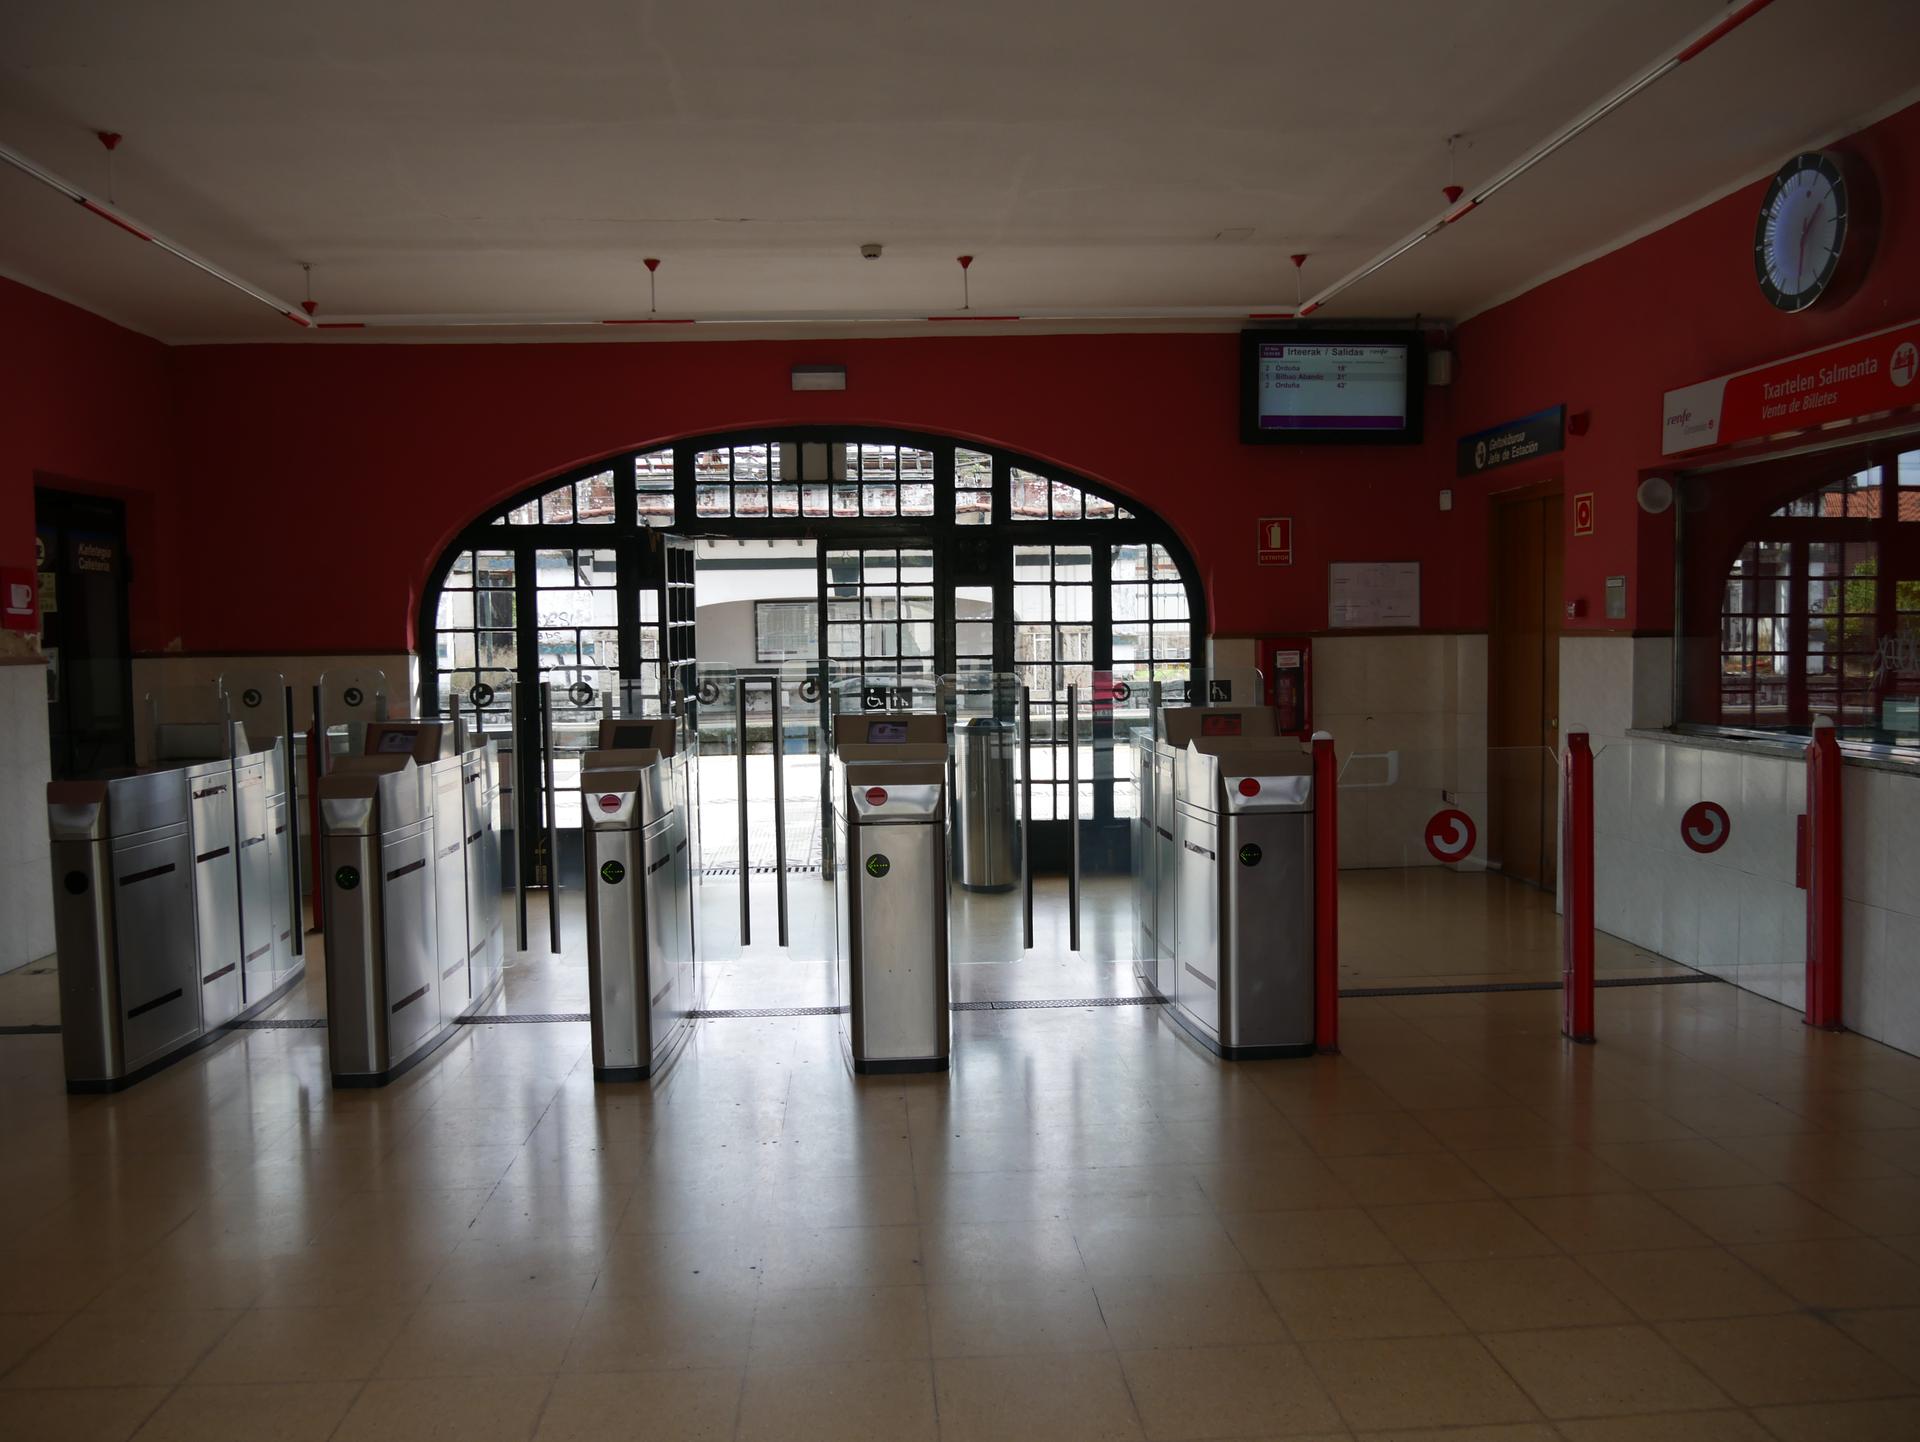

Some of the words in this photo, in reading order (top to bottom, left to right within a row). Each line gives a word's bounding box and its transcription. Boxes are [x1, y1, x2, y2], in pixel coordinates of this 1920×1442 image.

[1287, 348, 1321, 357] Irteerak
[1331, 348, 1364, 357] Salidas
[1762, 373, 1815, 401] Txartelen
[1818, 356, 1879, 387] Salmenta
[1667, 408, 1692, 427] renfe
[1761, 403, 1787, 420] Venta
[1788, 398, 1801, 413] de
[1802, 391, 1839, 411] Billetes
